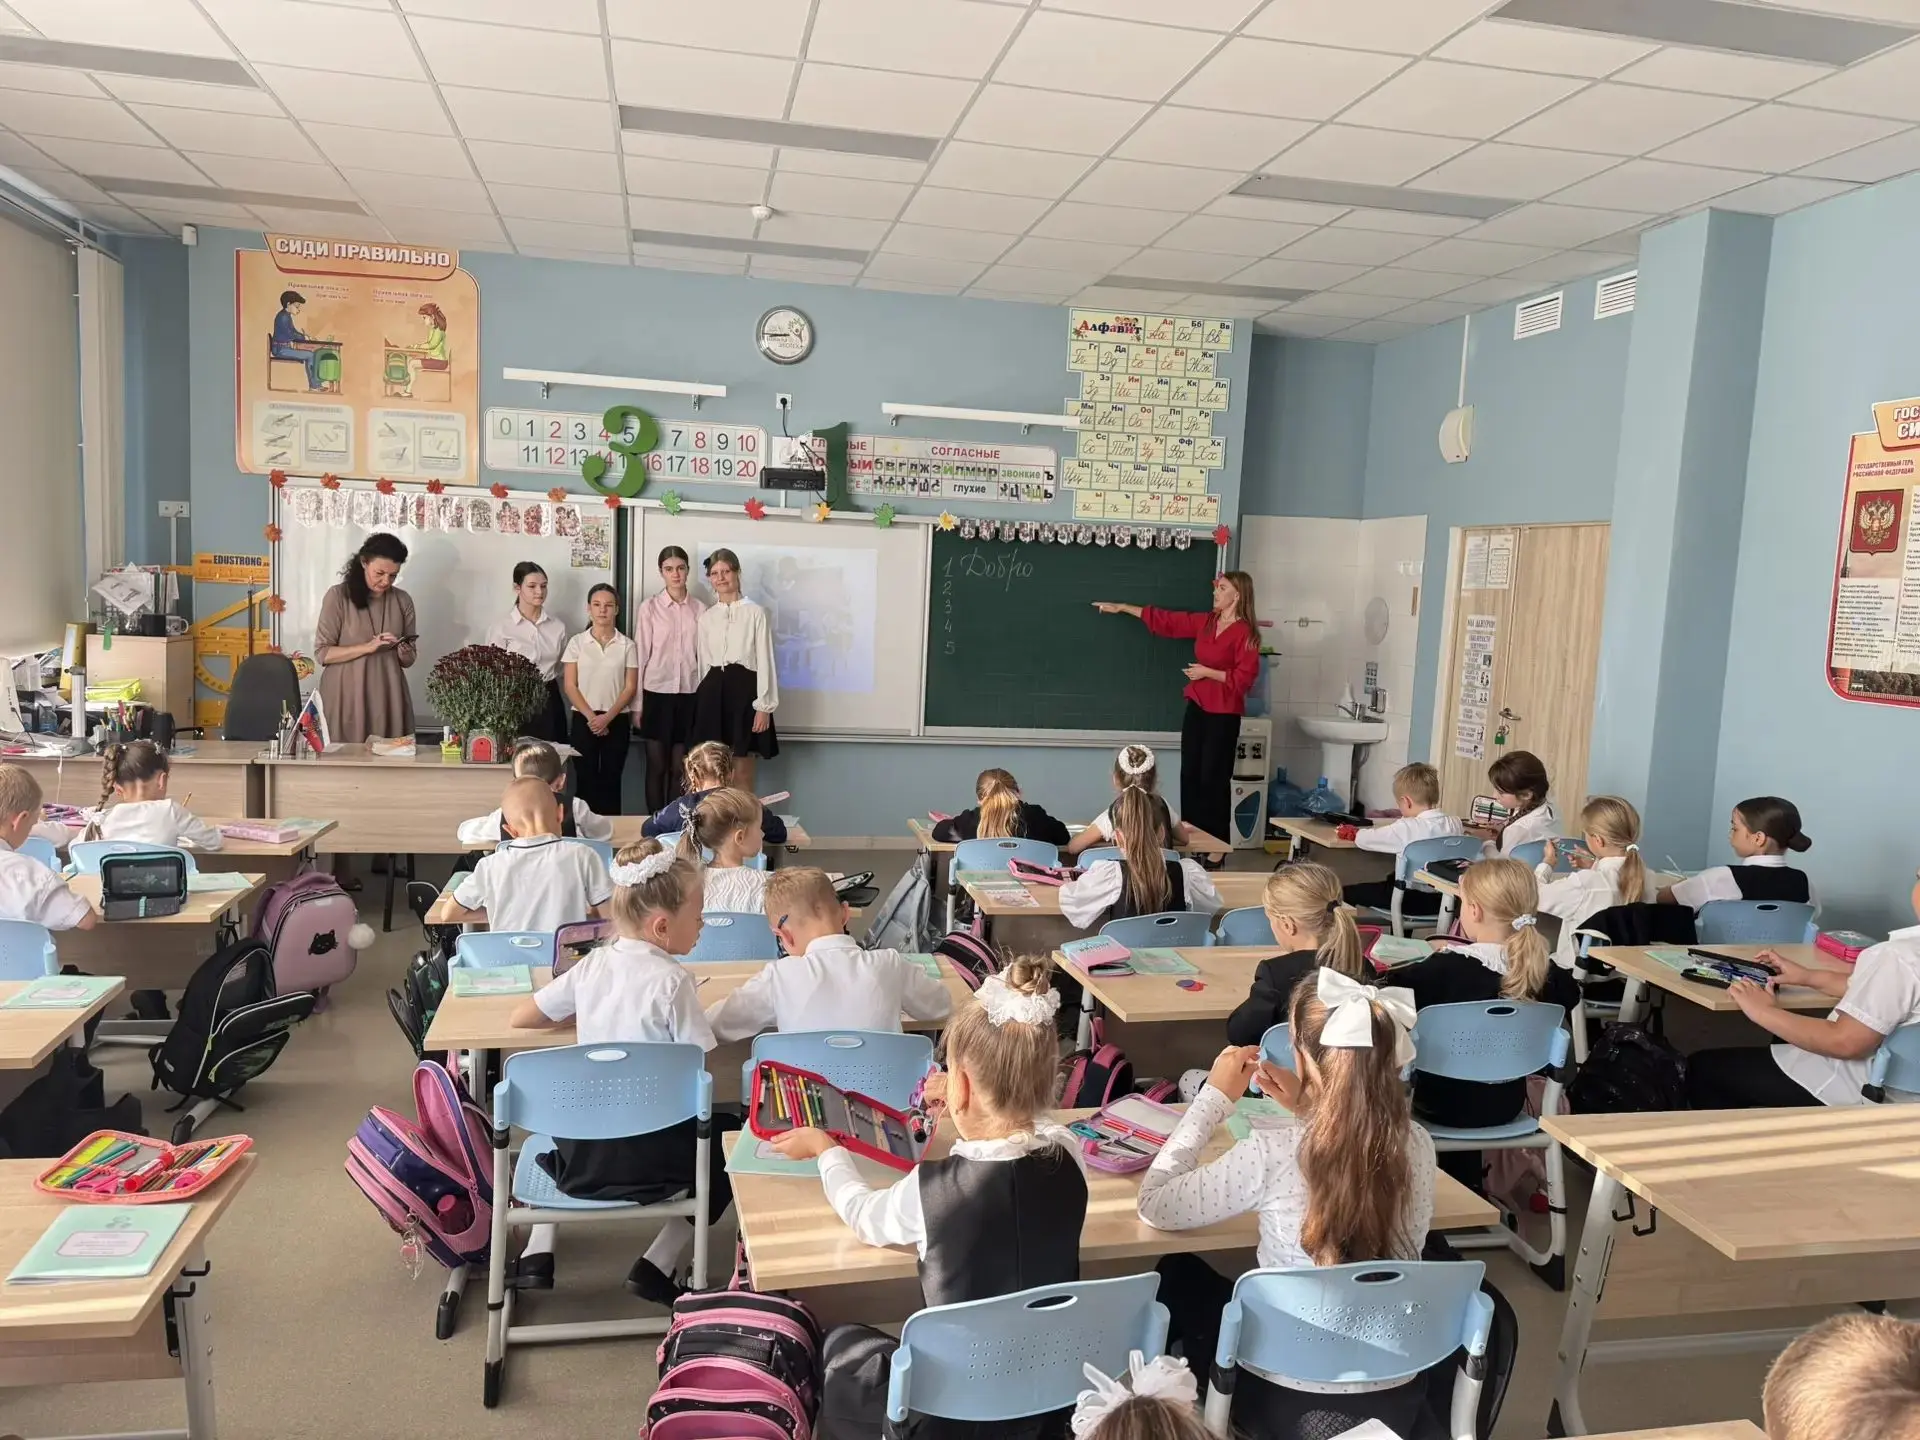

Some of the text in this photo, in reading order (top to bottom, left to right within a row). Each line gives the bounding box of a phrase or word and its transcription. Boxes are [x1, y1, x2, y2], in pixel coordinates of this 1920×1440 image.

[275, 238, 451, 268] СИДИ ПРАВИЛЬНО
[1079, 319, 1142, 335] Алфавит
[1162, 318, 1230, 330] Аа Бб Вв
[1114, 345, 1126, 354] Дд
[1174, 348, 1185, 357] Ёё
[1111, 404, 1123, 412] Нн
[1169, 408, 1181, 416] Пп
[1199, 411, 1210, 419] Рр
[499, 417, 512, 436] 0
[526, 419, 534, 438] 1
[550, 421, 561, 439] 2
[574, 423, 586, 441] 3
[623, 427, 635, 444] 5
[671, 430, 682, 448] 7
[695, 432, 706, 449] 8
[717, 433, 729, 450] 9
[738, 434, 756, 453] 10
[1154, 436, 1164, 445] Уу
[1178, 438, 1193, 447] Фф
[931, 446, 1001, 459] СОГЛАСНЫЕ
[523, 445, 539, 463] 11
[546, 447, 565, 466] 12
[570, 450, 588, 466] 13
[643, 454, 663, 472] 16
[667, 456, 686, 474] 17
[691, 457, 710, 475] 18
[714, 458, 733, 477] 19
[737, 459, 757, 478] 20
[1001, 469, 1041, 480] звонкие
[953, 484, 987, 495] глухие
[213, 555, 262, 566] EDUSTRONG
[960, 547, 1033, 592] Добро
